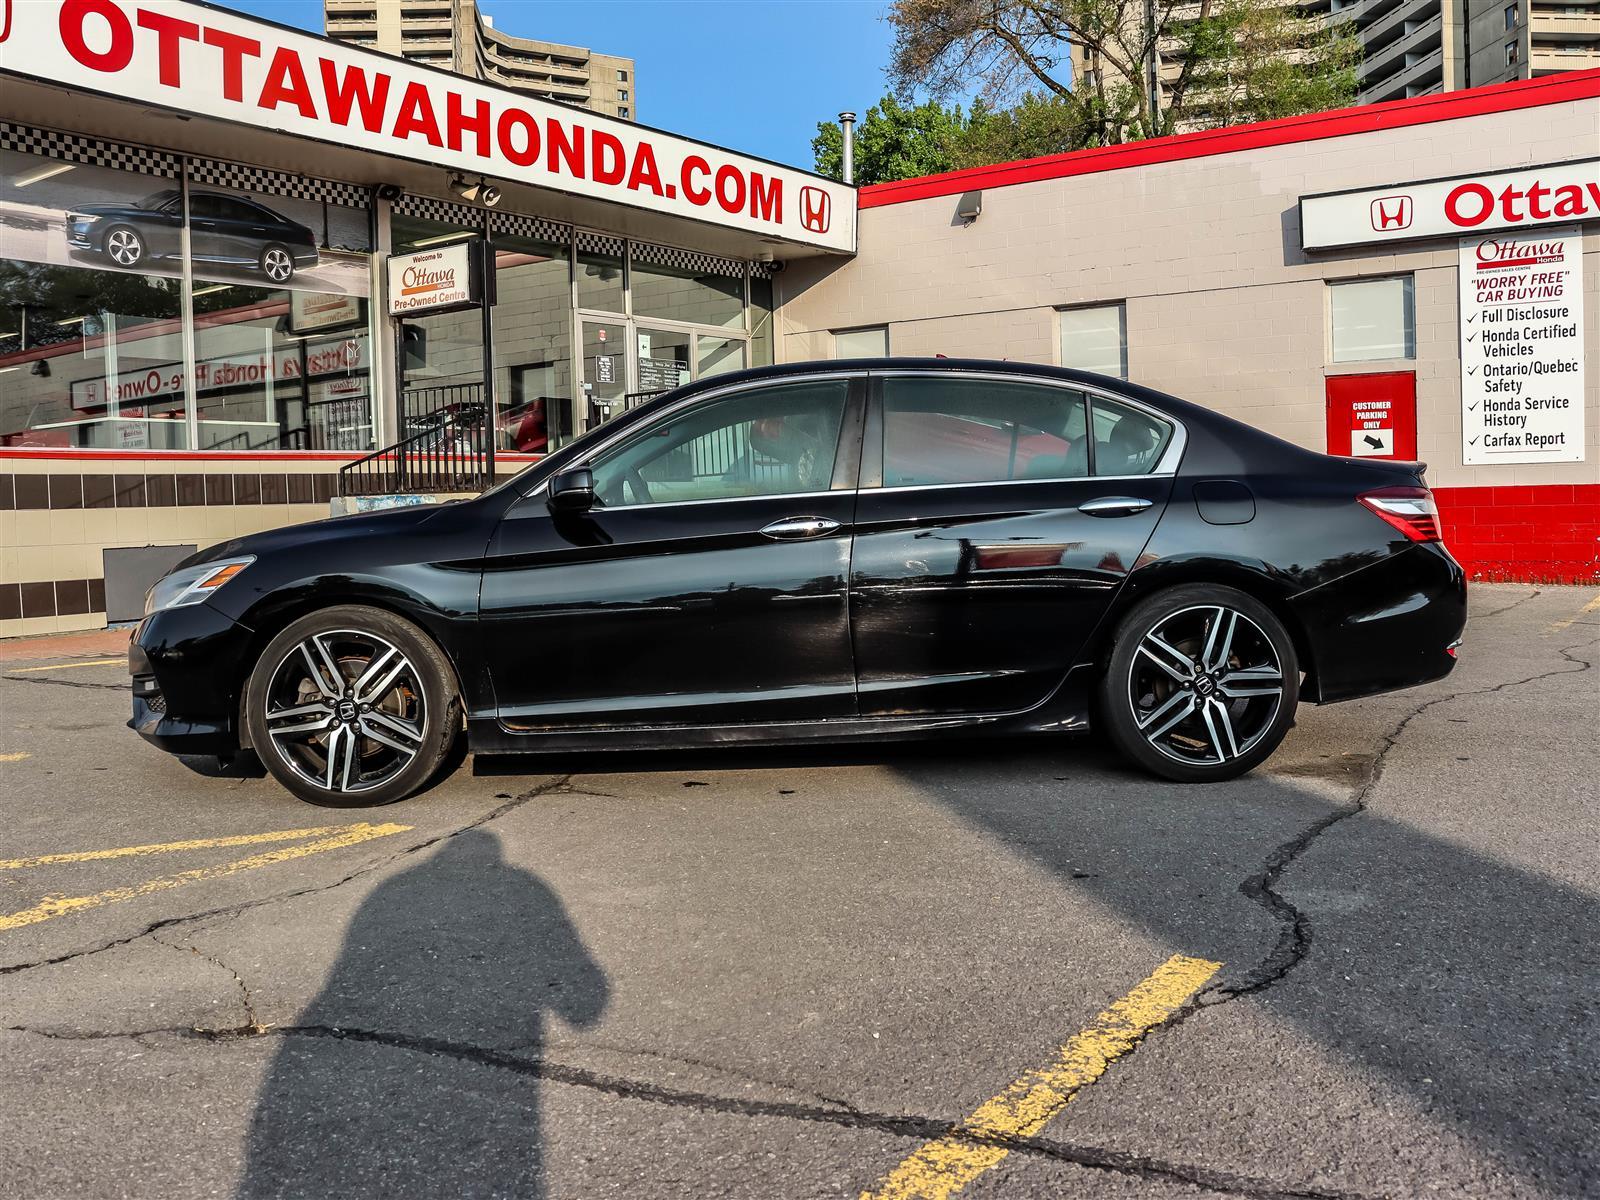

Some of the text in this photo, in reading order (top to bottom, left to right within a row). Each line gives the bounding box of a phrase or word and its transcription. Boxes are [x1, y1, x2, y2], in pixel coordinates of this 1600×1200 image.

[58, 0, 783, 225] OTTAWAHONDA.COM
[412, 254, 436, 263] Welcome
[1476, 240, 1565, 262] Ottawa
[1536, 256, 1563, 264] Honda
[402, 266, 455, 287] Ottawa
[1471, 271, 1570, 290] "WORRY FREE"
[394, 290, 466, 310] Pre-Owned Centre
[1476, 285, 1563, 303] CAR BUYING
[1482, 306, 1569, 323] Full Disclosure
[1482, 323, 1576, 342] Honda Certified
[1483, 343, 1534, 358] Vehicles
[1483, 359, 1578, 377] Ontario/Quebec
[1485, 378, 1522, 395] Safety
[1352, 401, 1391, 410] CUSTOMER
[1483, 396, 1569, 412] Honda Service
[1356, 411, 1387, 420] PARKING
[1484, 413, 1527, 429] History
[1363, 421, 1380, 429] ONLY
[1484, 432, 1565, 449] Carfax Report
